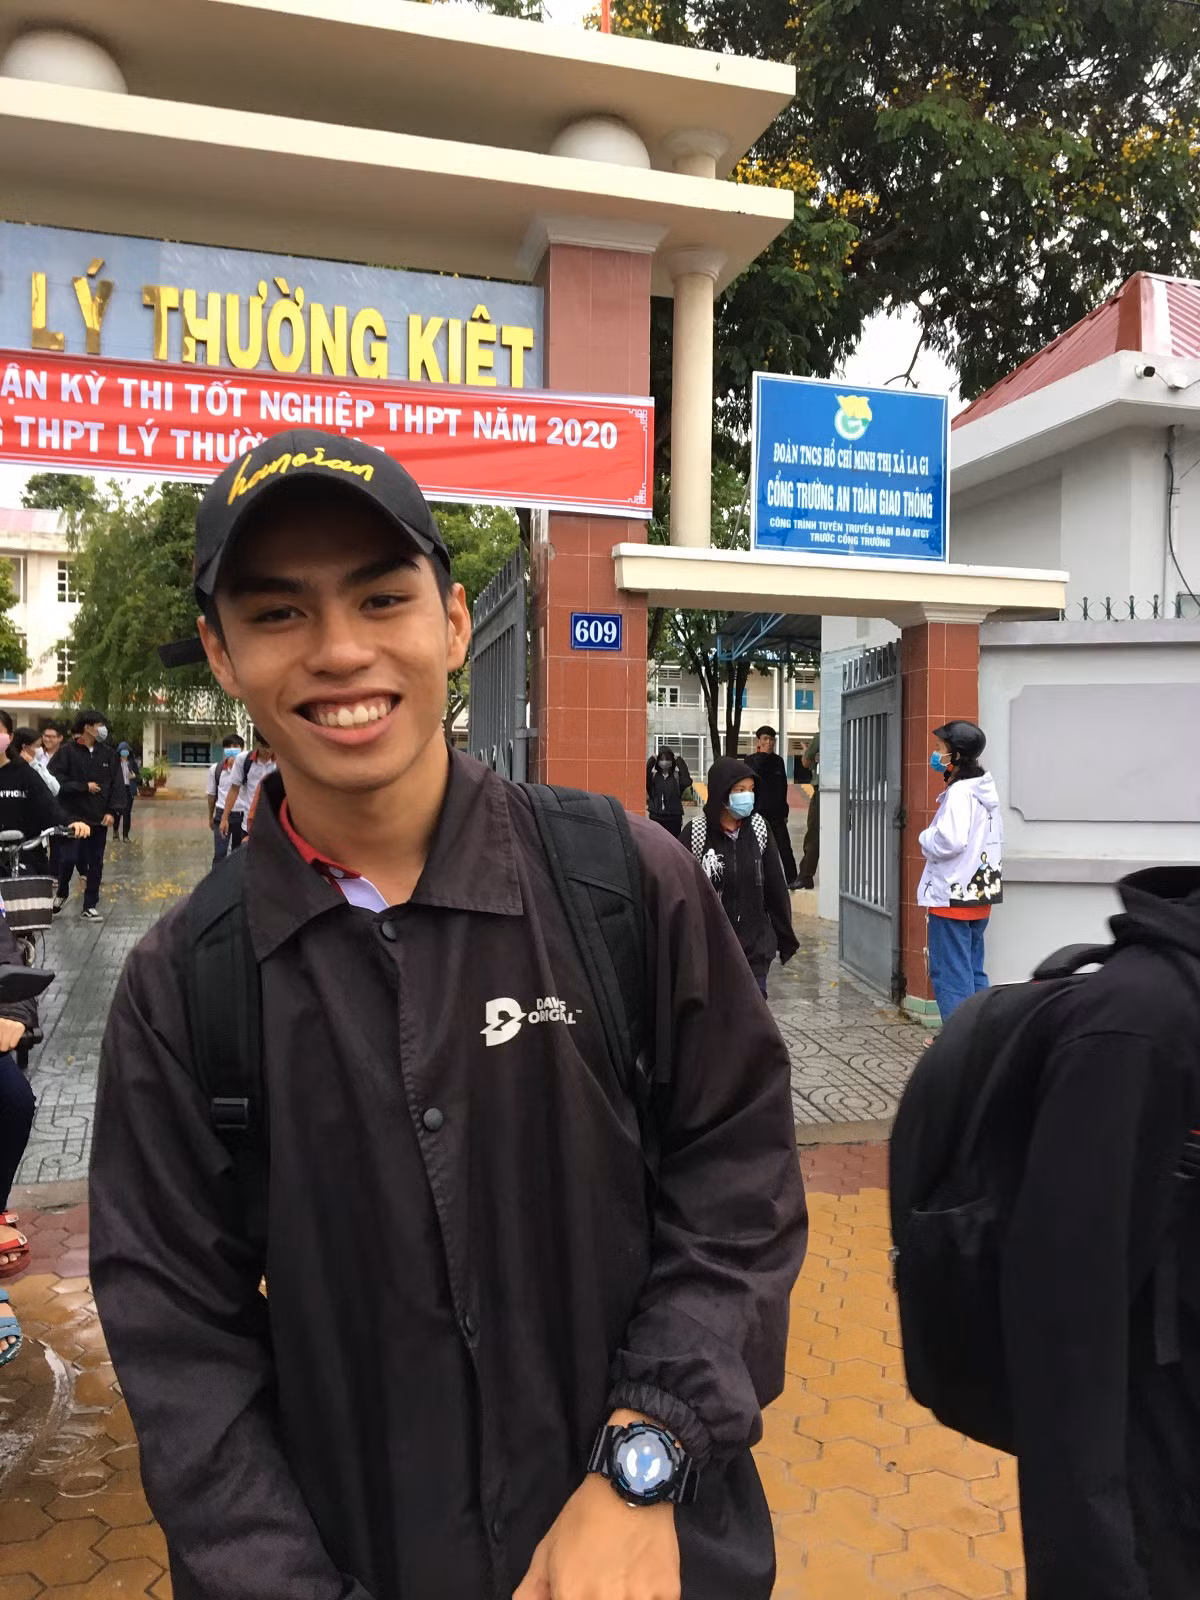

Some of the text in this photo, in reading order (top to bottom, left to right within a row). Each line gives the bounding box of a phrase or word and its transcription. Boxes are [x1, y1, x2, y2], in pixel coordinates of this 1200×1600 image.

[32, 257, 114, 354] LÝ
[143, 277, 388, 379] THƯỜNG
[60, 370, 106, 405] KỲ
[117, 378, 173, 411] THI
[184, 380, 247, 417] TỐT
[260, 390, 375, 433] NGHIỆP
[384, 402, 461, 437] THPT
[473, 407, 536, 443] NĂM
[546, 416, 618, 449] 2020
[14, 415, 104, 453] THPT
[118, 419, 159, 457] LÝ
[170, 427, 268, 464] THƯỜ
[800, 445, 822, 466] TNCS
[837, 443, 852, 469] CHÍ
[853, 450, 876, 472] MINH
[877, 452, 891, 477] THỊ
[907, 455, 918, 475] LA
[797, 477, 834, 512] TRƯỜNG
[836, 486, 850, 512] AN
[852, 482, 877, 514] TOÀN
[879, 489, 900, 516] GIAO
[903, 486, 933, 519] THÔNG
[769, 516, 791, 529] CÔNG
[575, 619, 617, 643] 609
